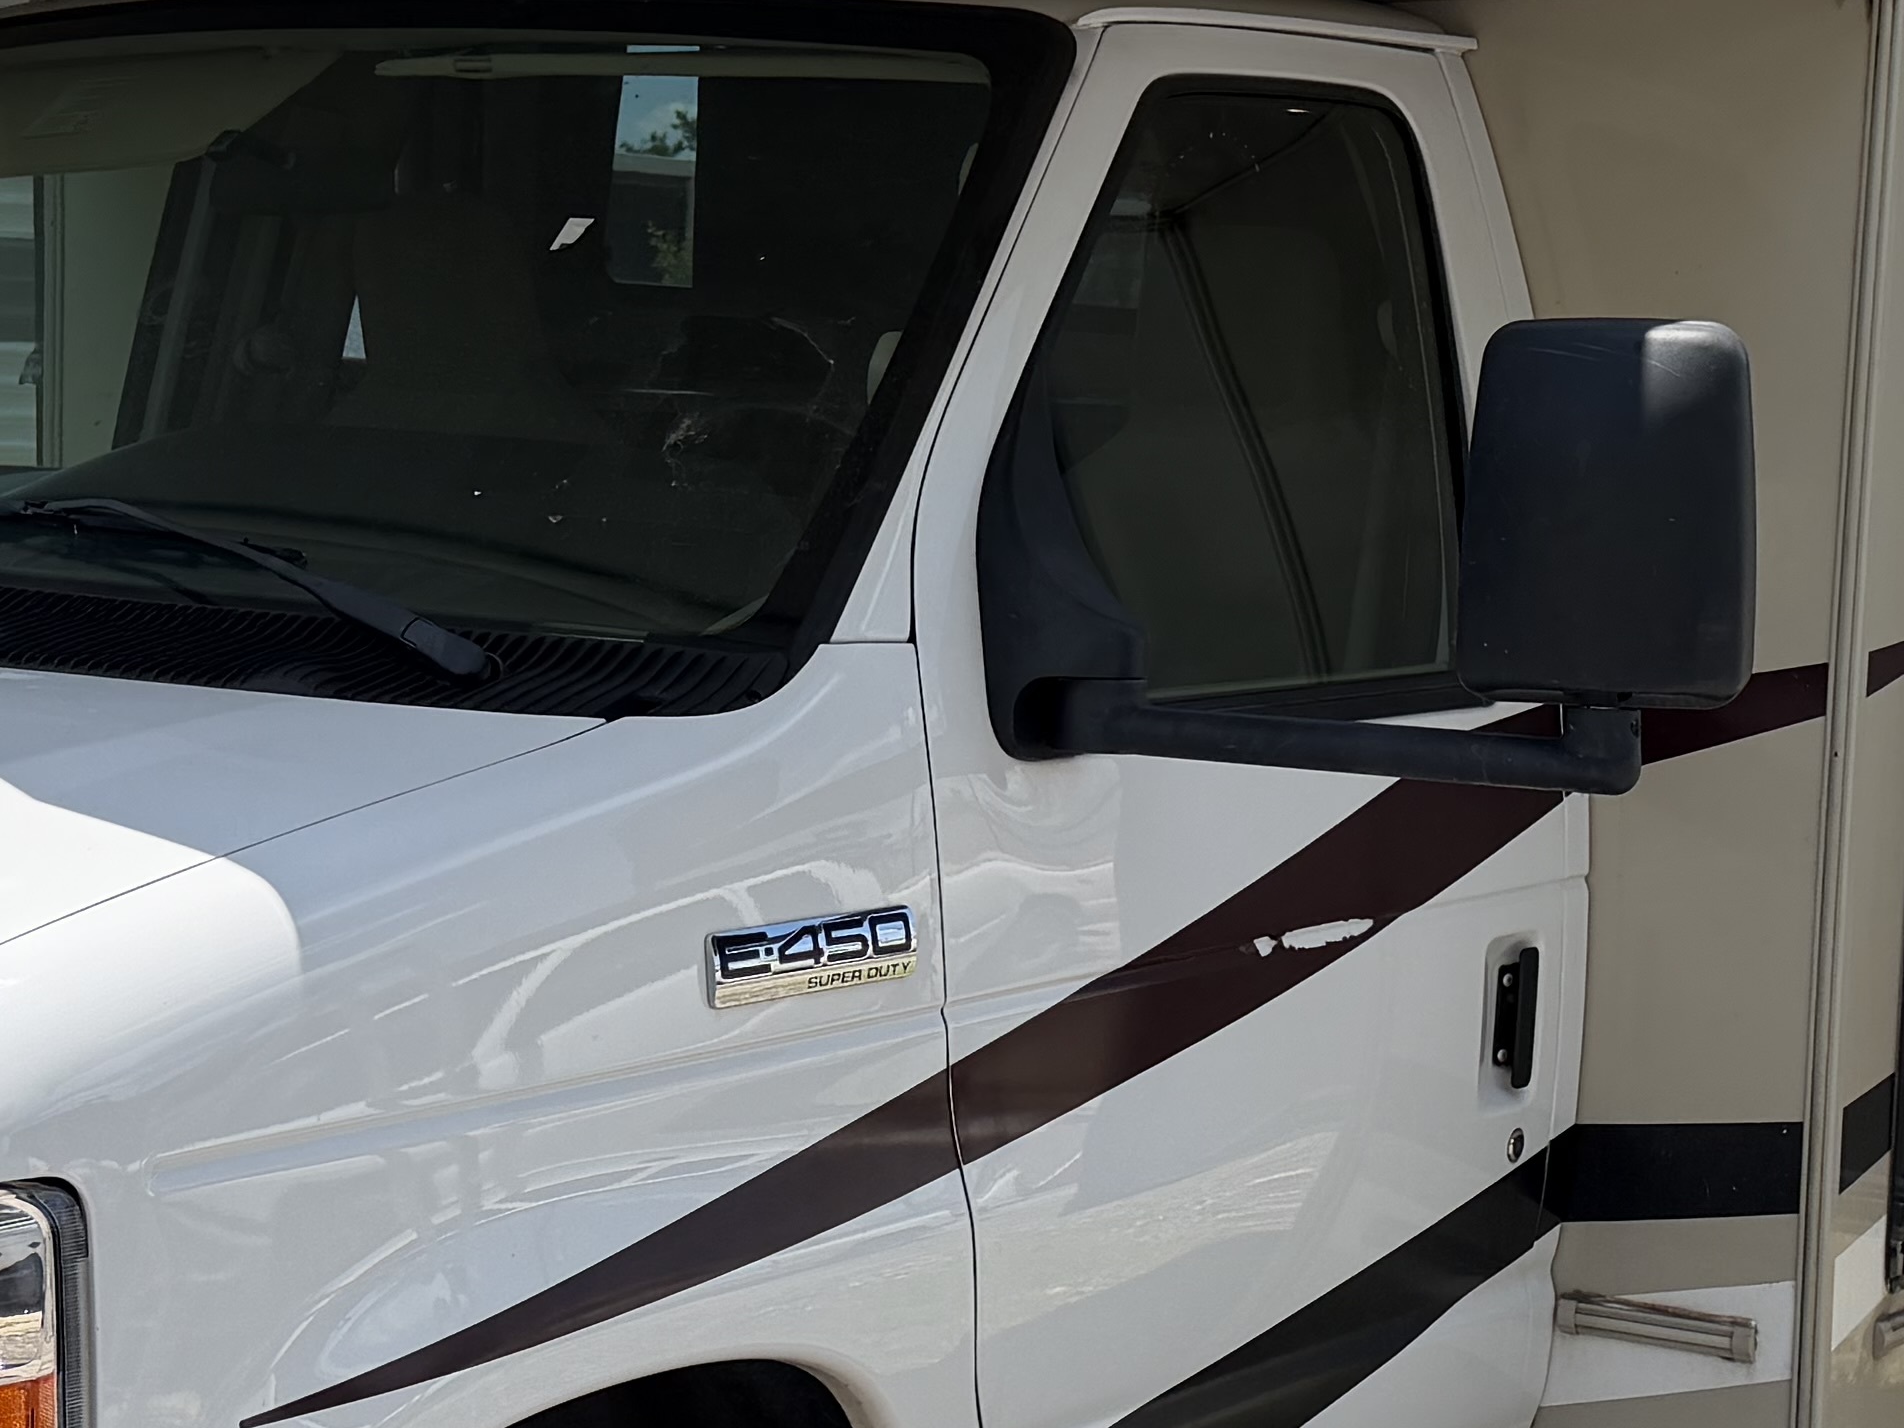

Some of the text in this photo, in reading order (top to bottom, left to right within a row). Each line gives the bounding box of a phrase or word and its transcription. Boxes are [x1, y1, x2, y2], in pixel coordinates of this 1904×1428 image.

[716, 912, 913, 979] E-450
[807, 961, 911, 989] SUPER DUTY
